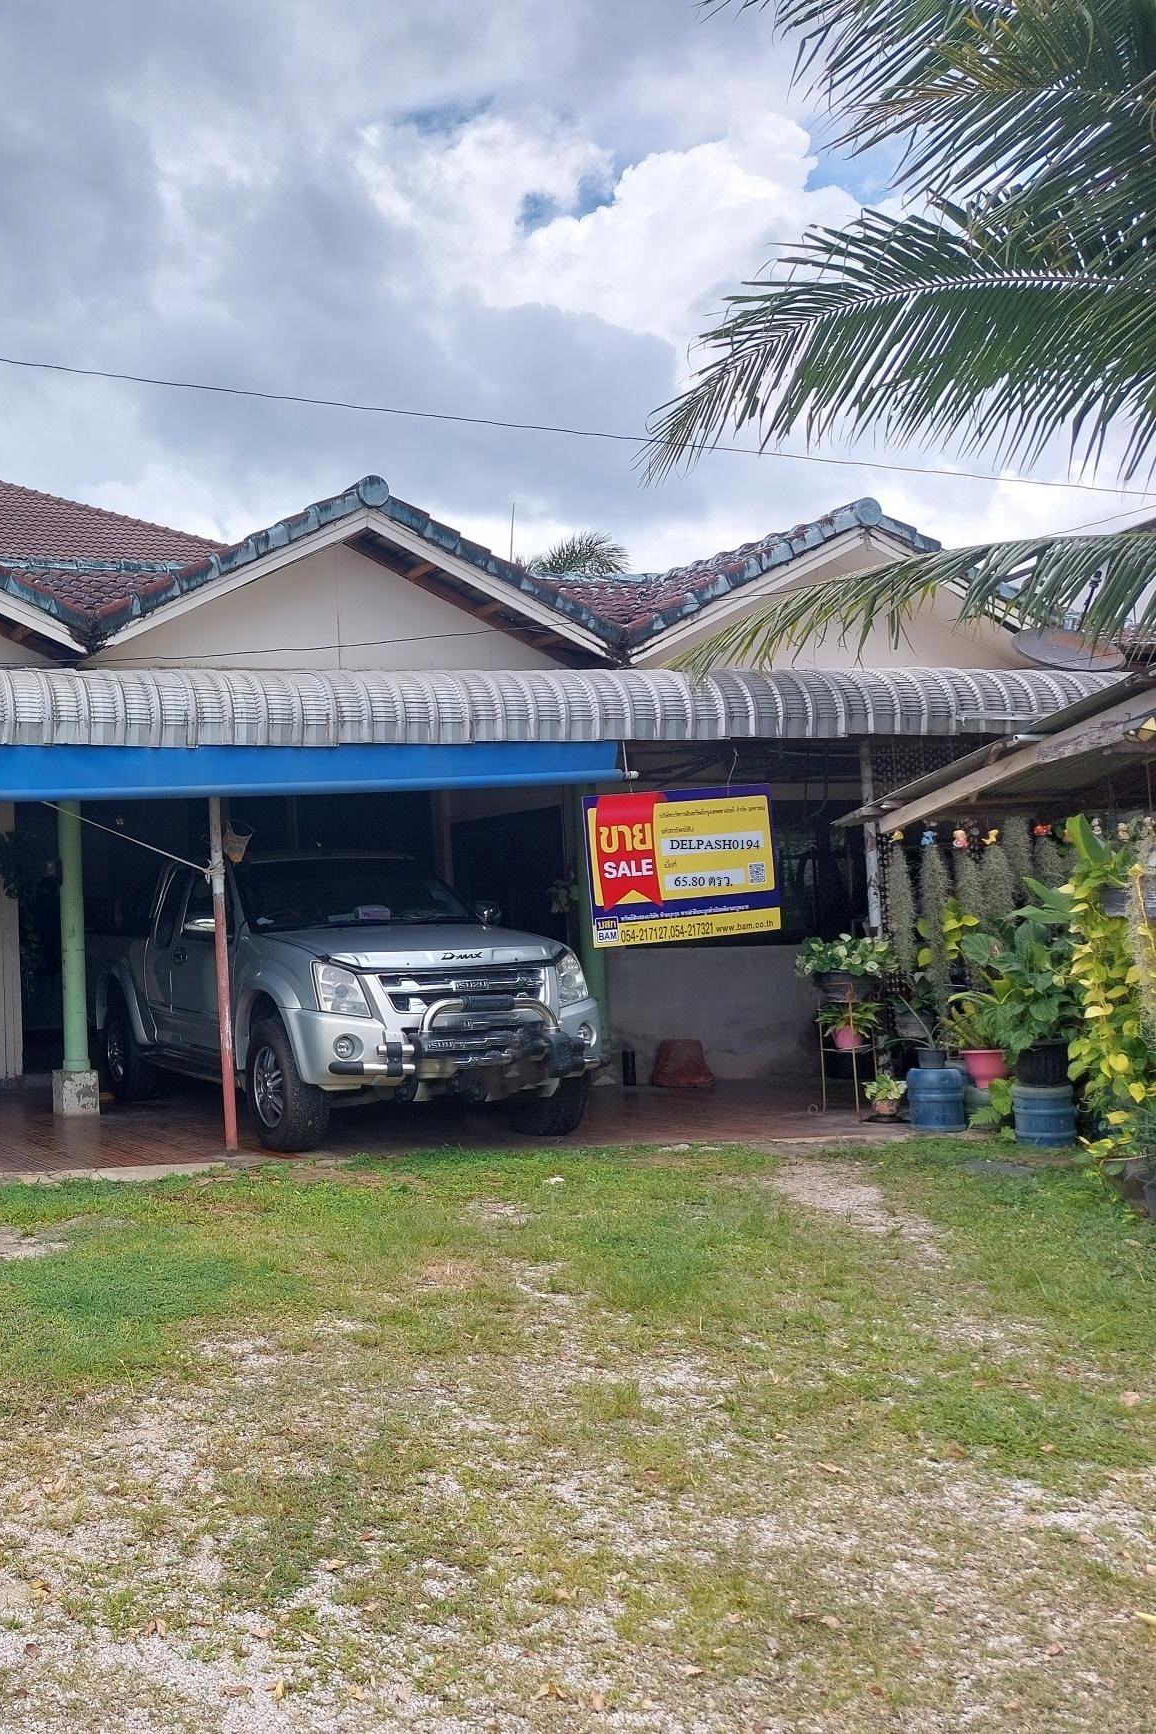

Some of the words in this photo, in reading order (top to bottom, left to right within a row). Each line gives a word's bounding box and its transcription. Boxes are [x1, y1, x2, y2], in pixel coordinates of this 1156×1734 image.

[600, 823, 653, 853] ขาย
[670, 839, 760, 850] DELPASH0194
[603, 858, 654, 879] SALE
[674, 876, 706, 887] 65.80
[598, 919, 617, 930] บสก
[598, 931, 618, 942] BAM
[620, 922, 714, 943] 054-217127,054-217321
[715, 920, 774, 933] www.bam.co.th
[455, 981, 487, 990] ISUZU
